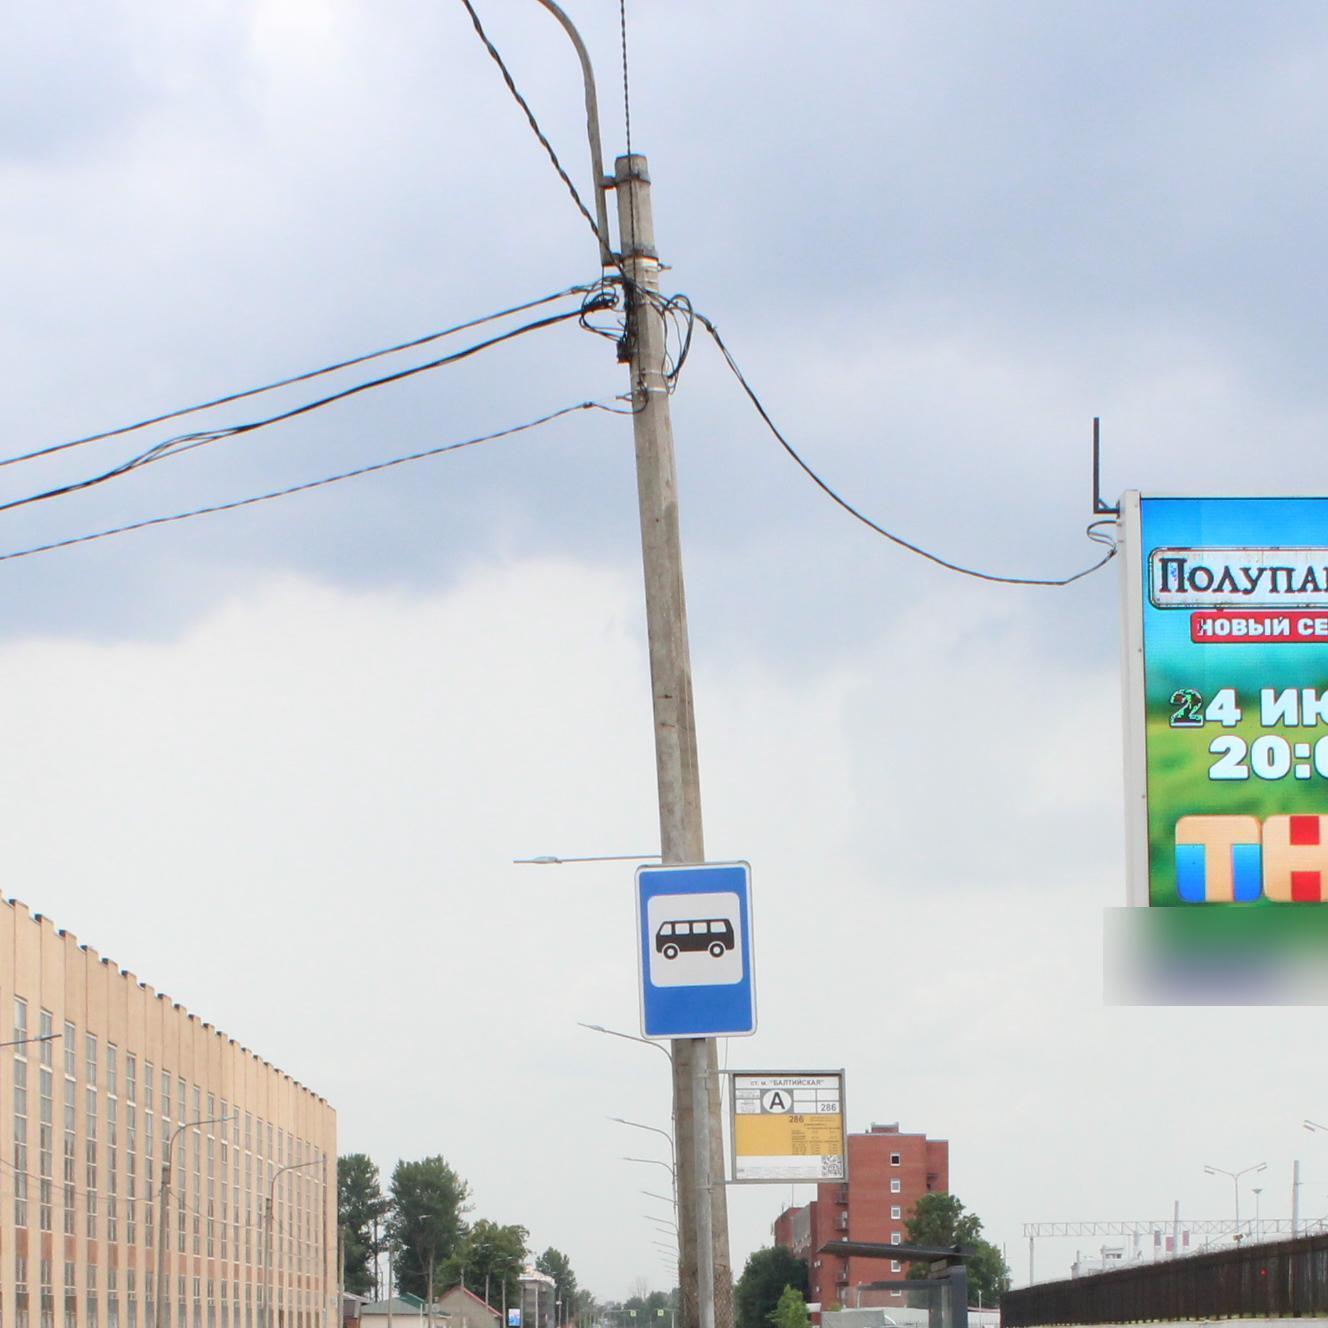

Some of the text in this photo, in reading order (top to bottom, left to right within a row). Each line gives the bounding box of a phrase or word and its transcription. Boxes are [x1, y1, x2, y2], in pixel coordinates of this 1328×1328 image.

[1198, 616, 1290, 637] НОВЫЙ
[1168, 687, 1242, 727] 24
[769, 1091, 786, 1111] А
[820, 1103, 837, 1112] 286
[788, 1115, 805, 1124] 286
